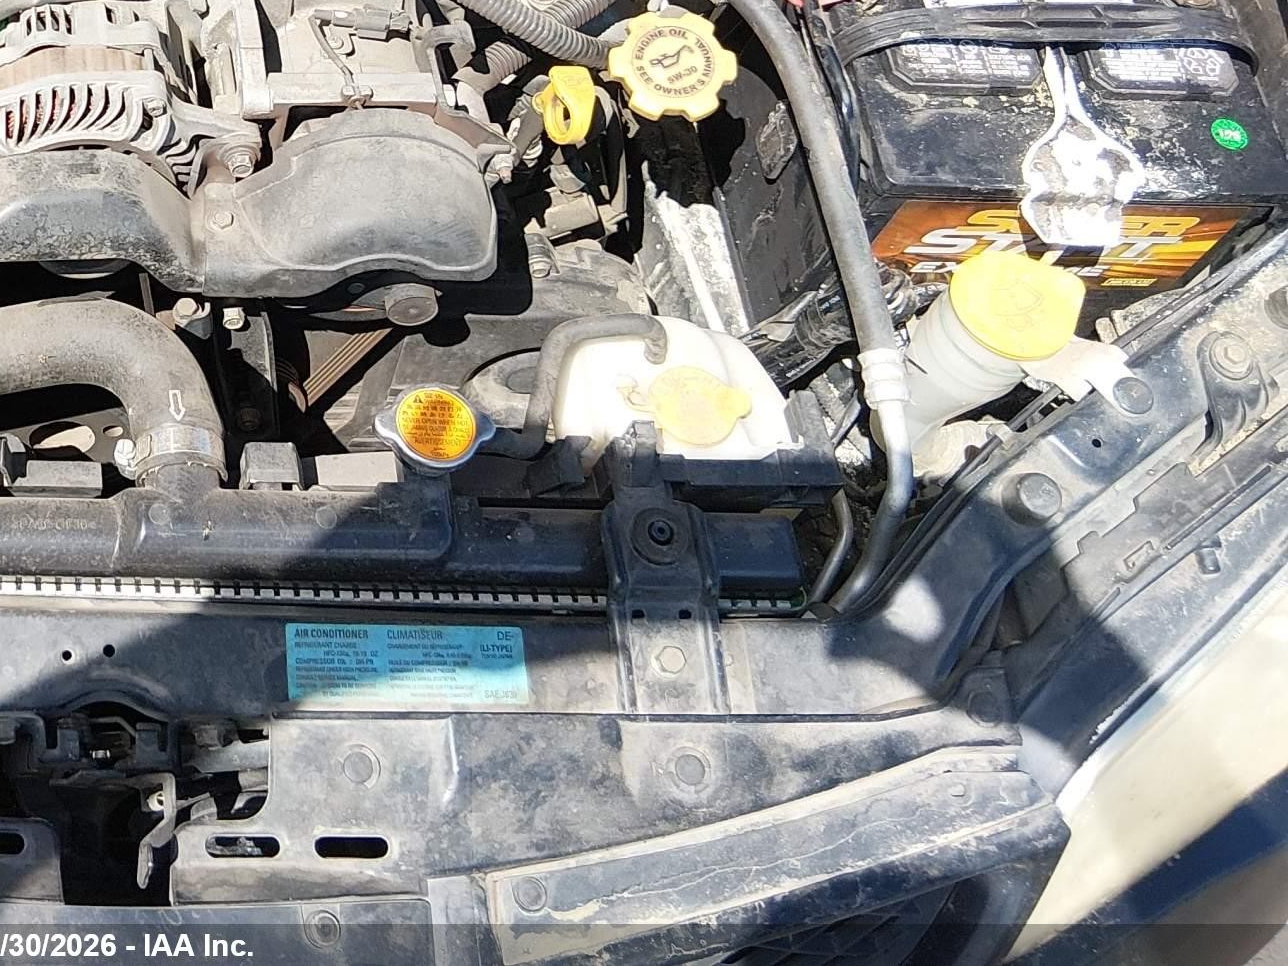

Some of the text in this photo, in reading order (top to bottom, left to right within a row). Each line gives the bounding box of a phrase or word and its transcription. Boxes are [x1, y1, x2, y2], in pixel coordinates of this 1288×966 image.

[635, 28, 689, 60] ENGINE OIL
[636, 65, 654, 85] SEE
[693, 37, 713, 78] MANUAL
[667, 65, 698, 84] 5W-30
[955, 209, 1200, 237] SER
[294, 629, 369, 640] AIR CONDITIONER
[387, 629, 443, 640] CLIMATISEUR
